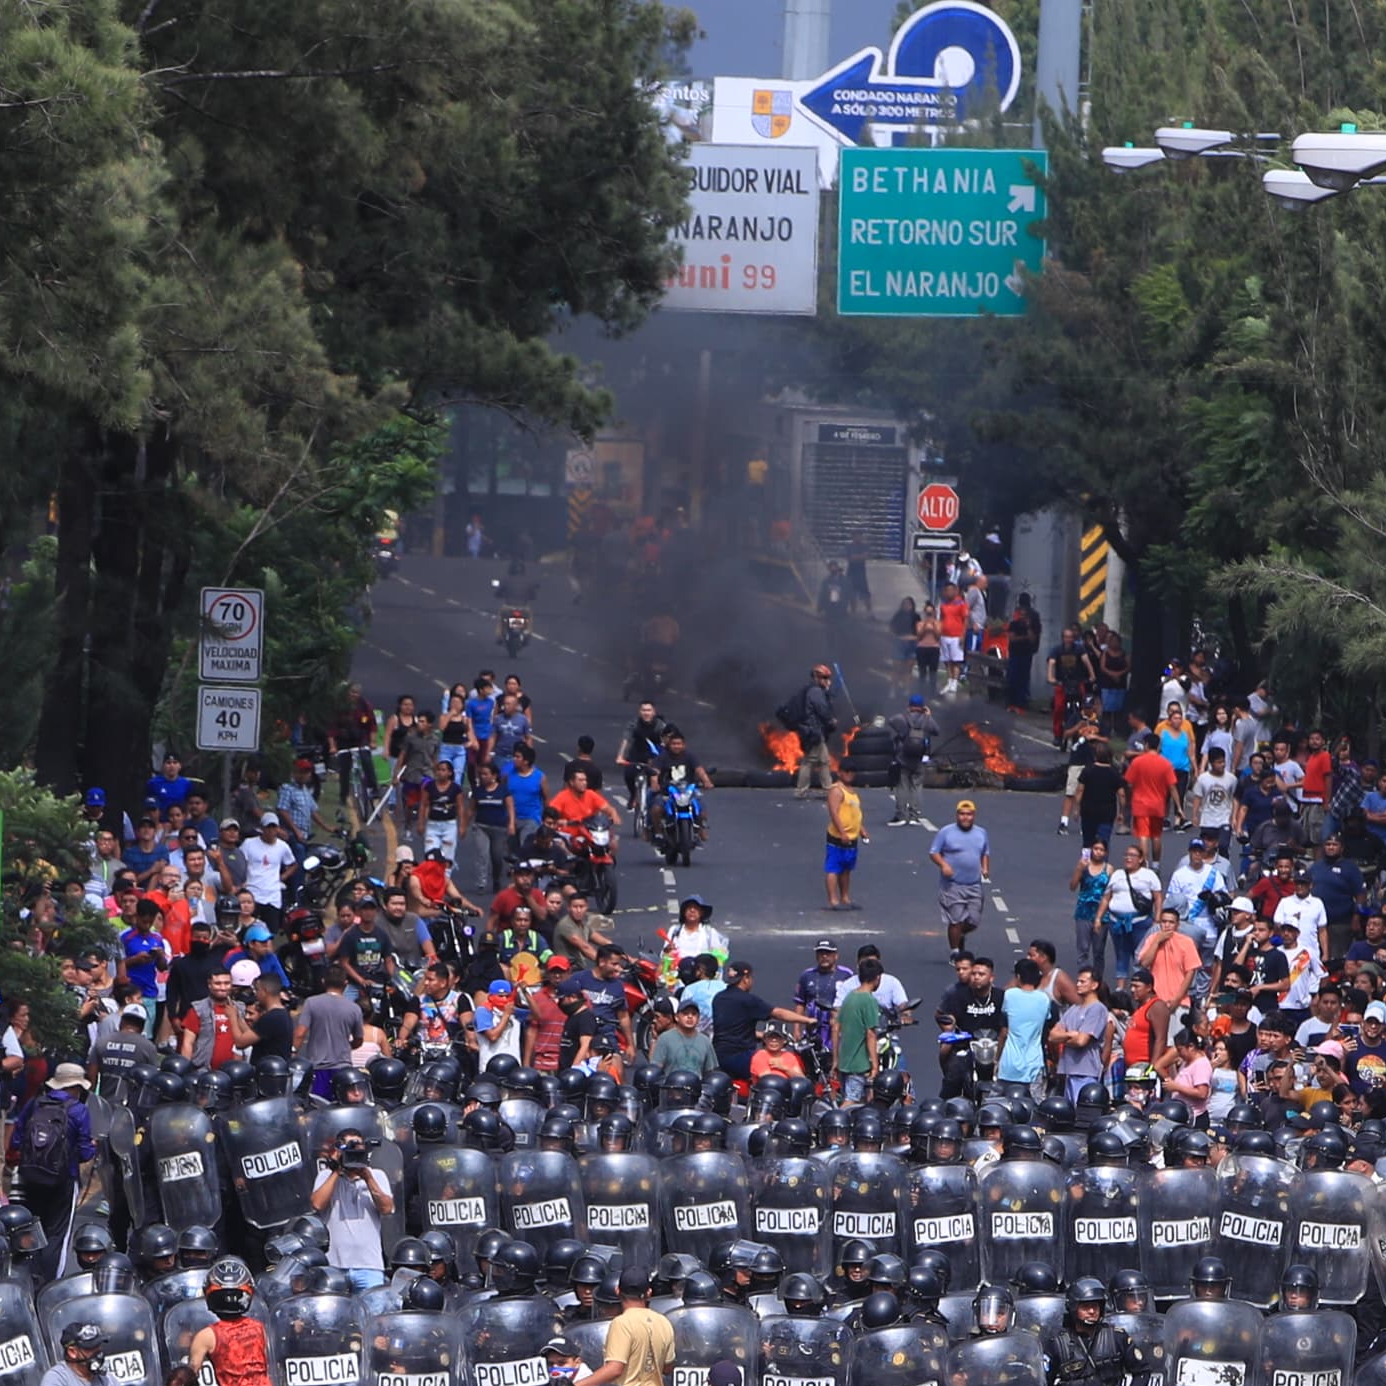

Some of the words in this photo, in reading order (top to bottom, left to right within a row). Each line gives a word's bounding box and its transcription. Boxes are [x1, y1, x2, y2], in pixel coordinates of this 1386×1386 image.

[663, 86, 709, 101] entos
[833, 89, 895, 102] CONDADO
[896, 92, 958, 106] NARANO
[831, 103, 842, 114] A
[688, 166, 758, 192] BUIDOR
[764, 168, 809, 195] VIAL
[852, 166, 996, 194] BETHANIA
[674, 214, 793, 242] NARANJO
[850, 219, 963, 246] RETORNO
[967, 220, 1018, 247] SUR
[743, 264, 776, 290] 99
[850, 271, 880, 297] EL
[885, 271, 999, 299] NARANJO
[921, 497, 954, 518] ALTO
[219, 602, 245, 621] 70
[205, 647, 257, 660] VELOCIDAD
[211, 660, 251, 671] MAXIMA
[204, 695, 254, 709] CAMIONES
[215, 710, 241, 728] 40
[217, 731, 238, 741] KPH
[244, 1146, 300, 1177] POLICIA
[430, 1199, 484, 1222] POLICIA
[515, 1201, 568, 1228] POLICIA
[757, 1210, 817, 1230] POLICIA
[836, 1213, 895, 1235] POLICIA
[916, 1216, 972, 1240] POLICIA
[1077, 1219, 1135, 1240] POLICIA
[1154, 1218, 1209, 1244] POLICIA
[1223, 1213, 1280, 1242] POLICIA
[1301, 1222, 1360, 1246] POLICIA
[288, 1356, 356, 1383] POLICIA
[478, 1360, 547, 1386] POLICIA
